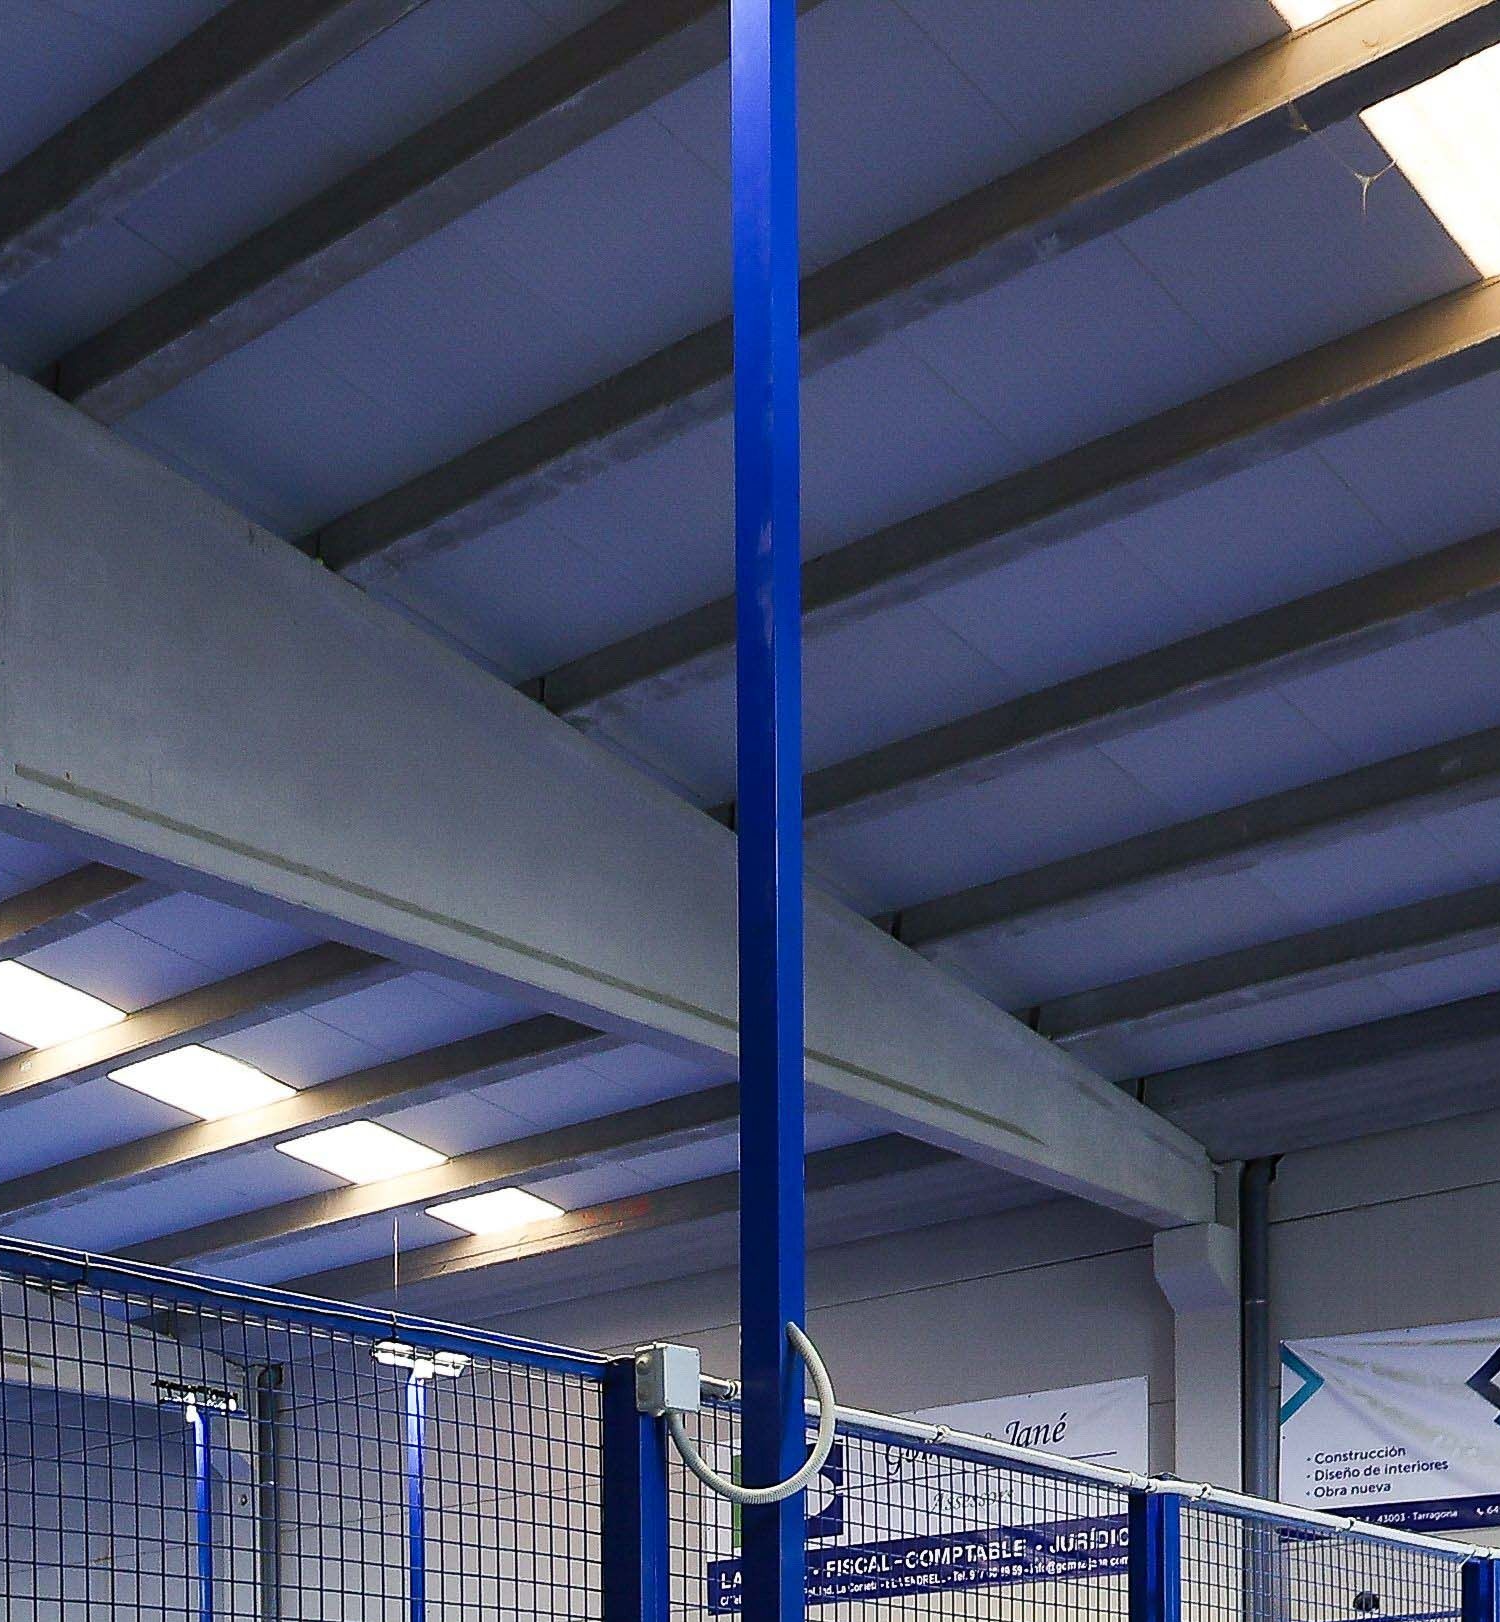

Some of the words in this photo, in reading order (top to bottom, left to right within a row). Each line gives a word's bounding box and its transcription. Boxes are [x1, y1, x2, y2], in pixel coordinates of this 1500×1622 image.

[1005, 1412, 1067, 1447] Jané
[1314, 1446, 1406, 1465] Construcción
[1314, 1467, 1360, 1481] Diseño
[1364, 1465, 1381, 1477] de
[1314, 1486, 1347, 1498] Obra
[1351, 1482, 1391, 1495] nueva
